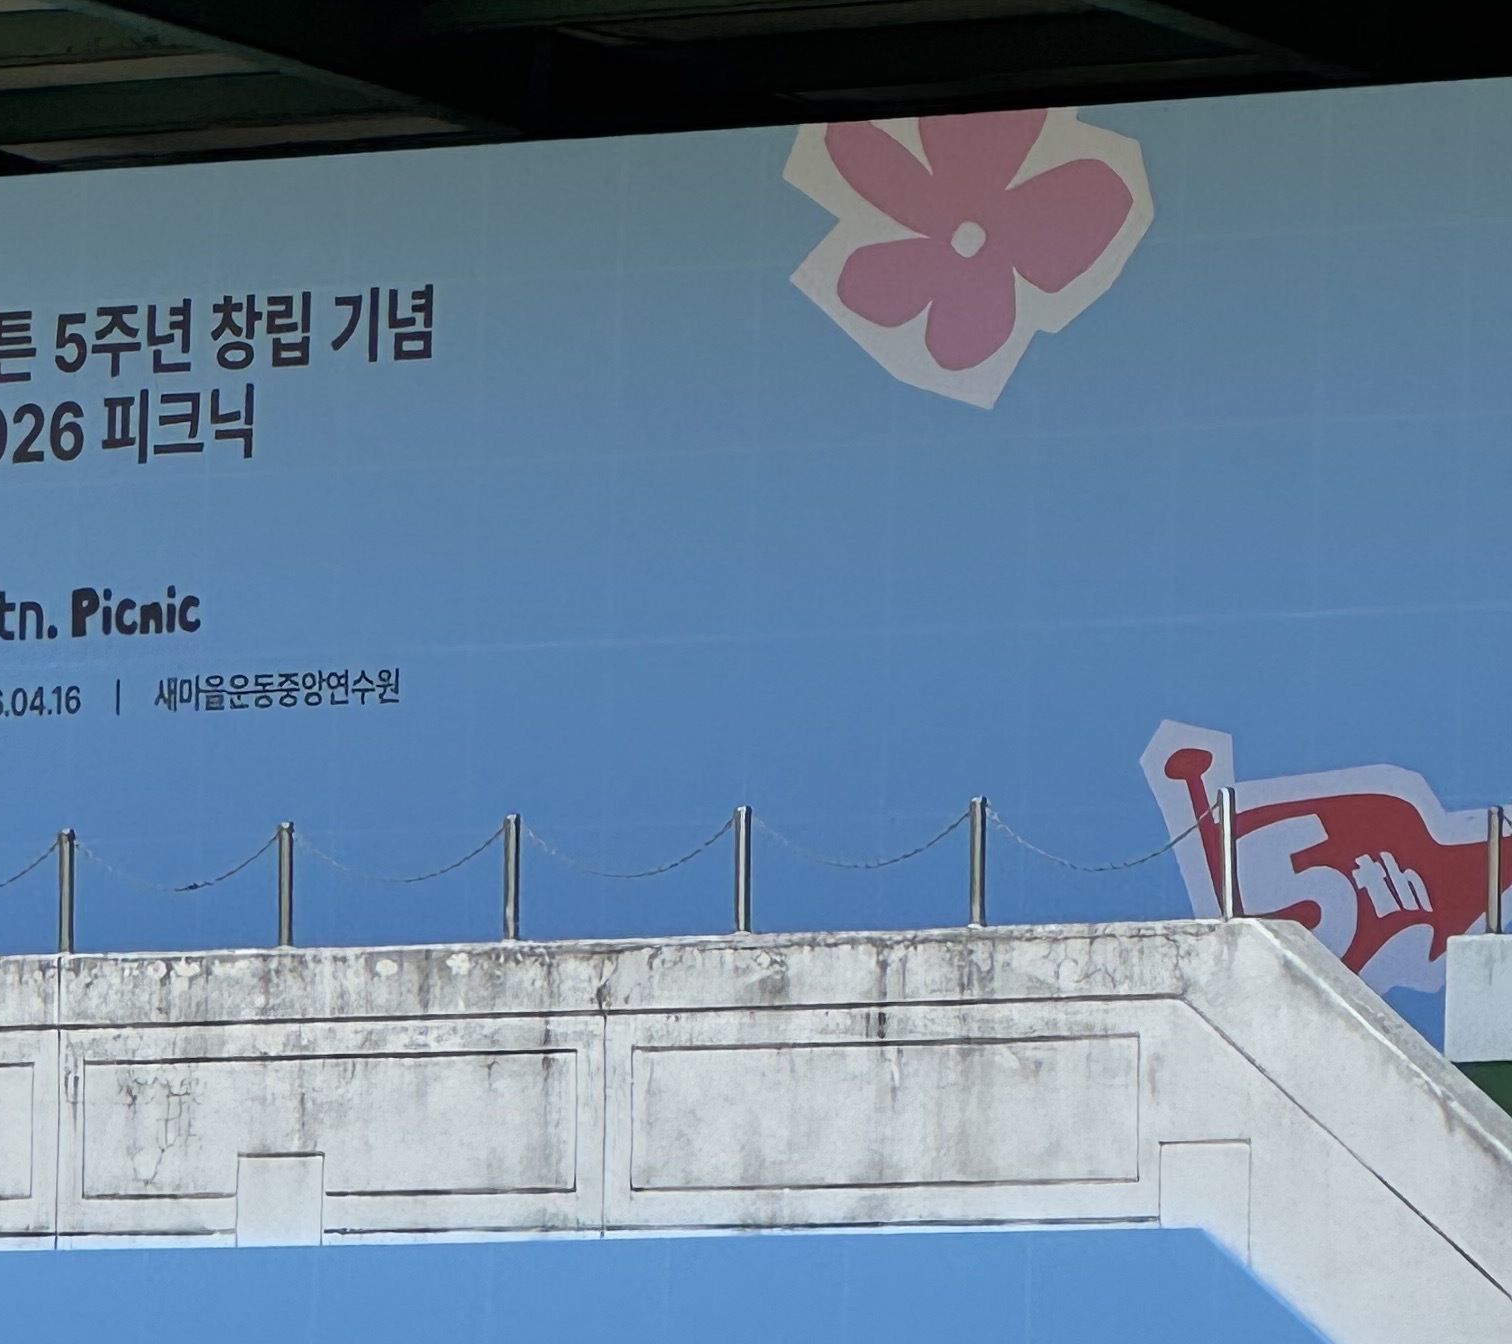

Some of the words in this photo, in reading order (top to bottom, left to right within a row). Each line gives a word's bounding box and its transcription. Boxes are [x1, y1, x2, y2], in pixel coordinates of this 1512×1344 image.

[54, 297, 192, 378] 5주년
[210, 291, 312, 370] 창립
[331, 283, 434, 363] 기념
[101, 383, 255, 465] 피크닉
[71, 585, 201, 638] Picnic
[154, 667, 400, 712] 새마을운동중앙연수원
